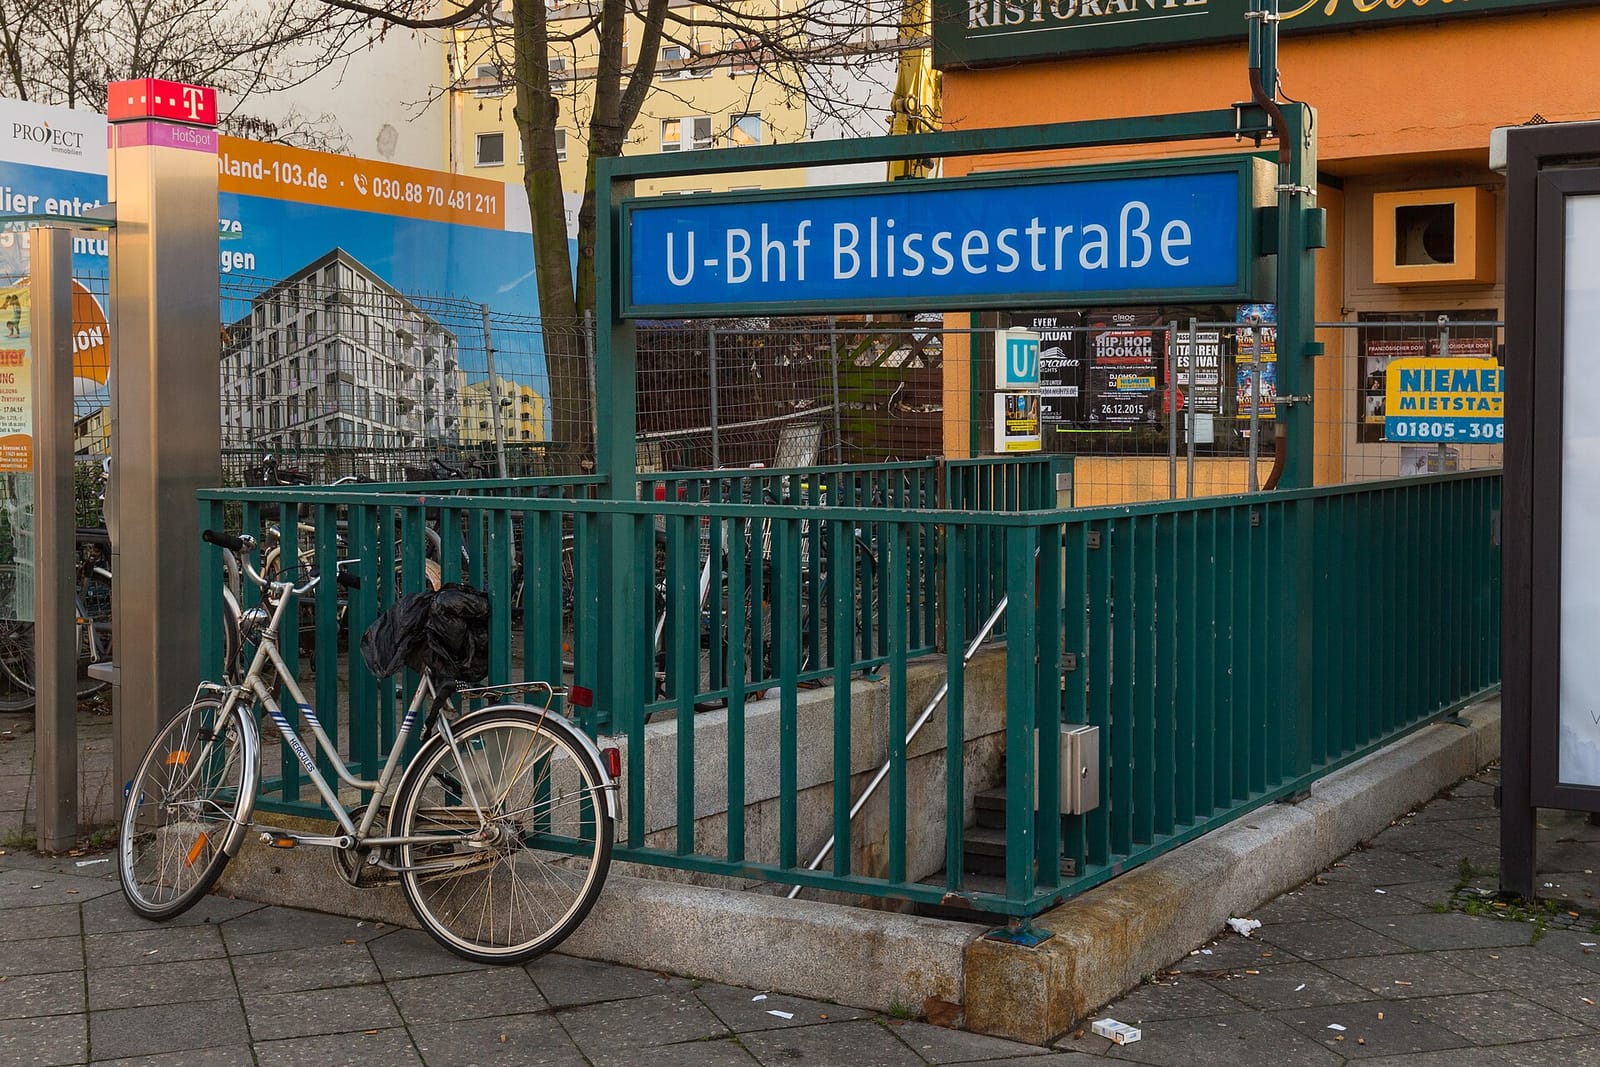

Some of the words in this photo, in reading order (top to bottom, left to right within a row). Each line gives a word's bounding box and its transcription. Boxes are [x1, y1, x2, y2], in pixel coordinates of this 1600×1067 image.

[172, 128, 211, 146] HotSpot
[0, 186, 39, 214] ier
[373, 177, 423, 203] 030.88
[427, 186, 444, 207] 70
[448, 190, 472, 211] 481
[475, 194, 497, 214] 211
[665, 219, 813, 287] U-Bhf
[832, 201, 1193, 280] Blissestraße
[1033, 318, 1057, 327] EVERY
[1096, 336, 1119, 347] HIP
[1124, 336, 1152, 347] HOP
[1475, 342, 1490, 350] DOM
[1012, 344, 1038, 378] U7
[1096, 347, 1152, 357] HOOKAH
[1101, 404, 1144, 414] 26.12.2015
[289, 737, 315, 773] HERCULES
